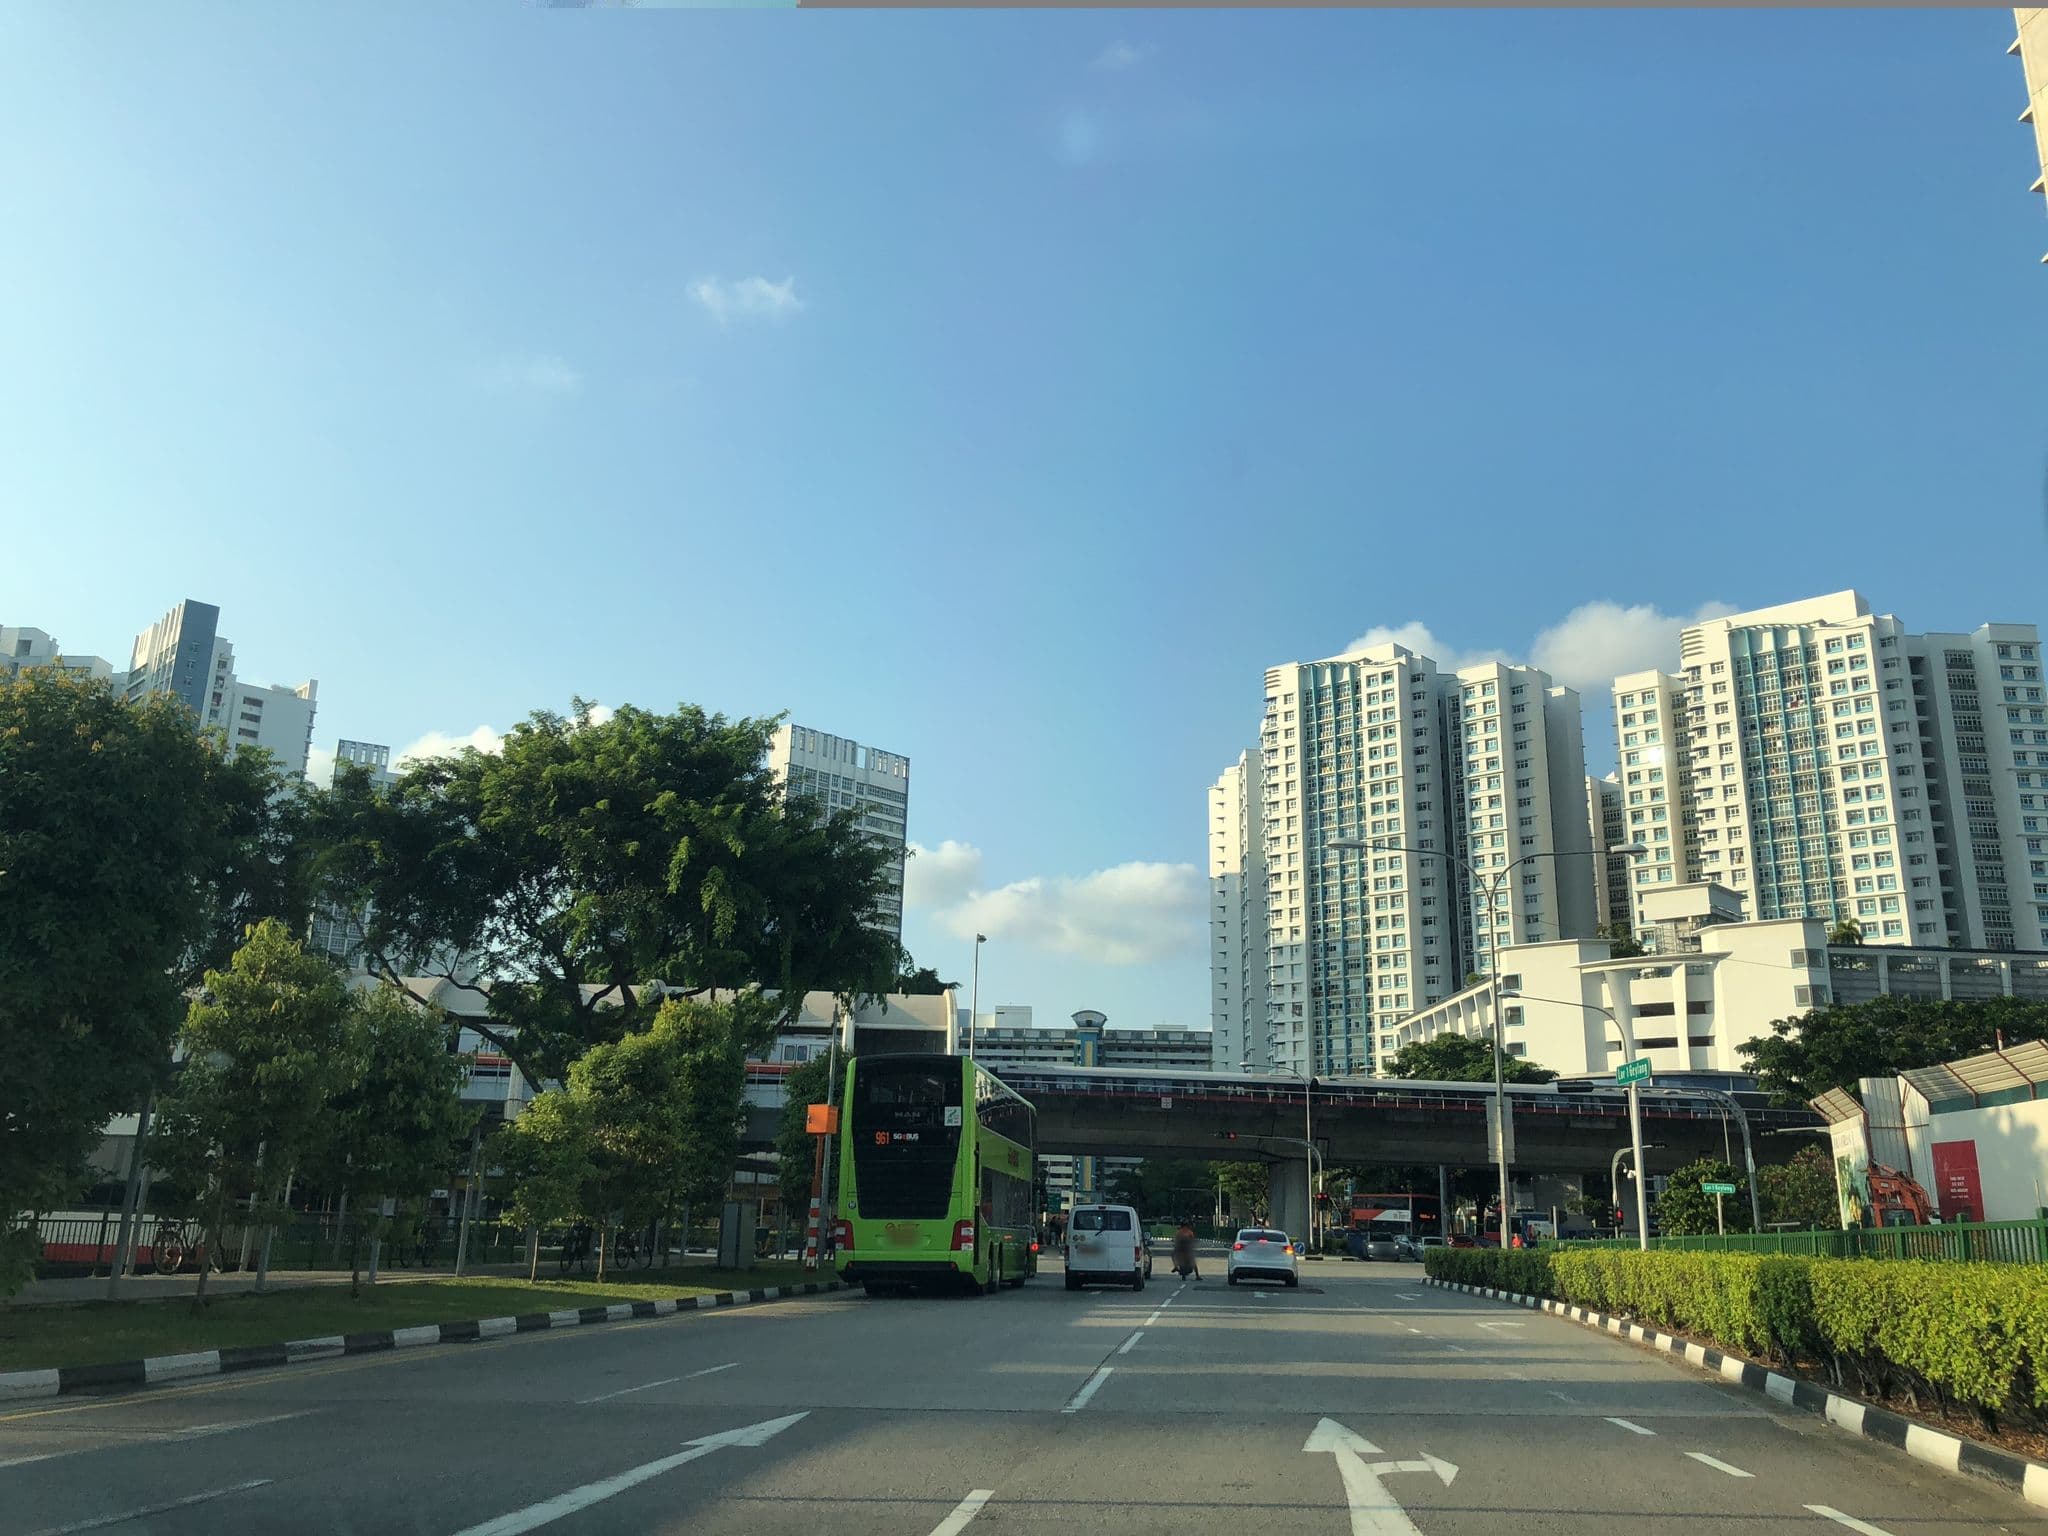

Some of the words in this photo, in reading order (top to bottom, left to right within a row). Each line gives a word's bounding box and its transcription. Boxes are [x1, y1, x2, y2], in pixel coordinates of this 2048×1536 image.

[1617, 1067, 1626, 1080] Lor
[1630, 1062, 1648, 1078] Geylang
[875, 1131, 890, 1145] 961
